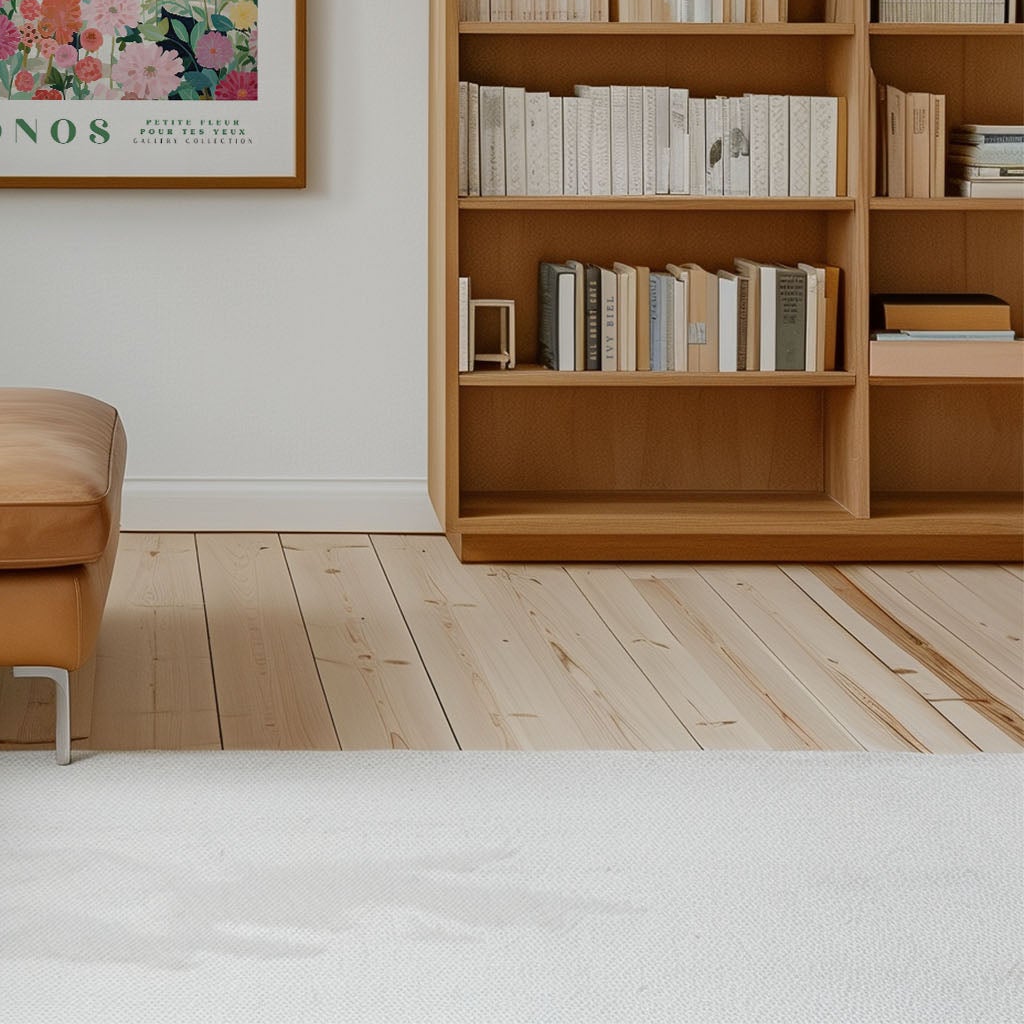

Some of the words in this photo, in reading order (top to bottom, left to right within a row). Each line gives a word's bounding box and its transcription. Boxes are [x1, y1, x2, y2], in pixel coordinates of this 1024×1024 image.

[589, 280, 598, 304] CATS
[606, 296, 615, 327] BIEL
[589, 309, 598, 339] ABOUT
[589, 343, 598, 361] ALL
[606, 336, 615, 359] IVY
